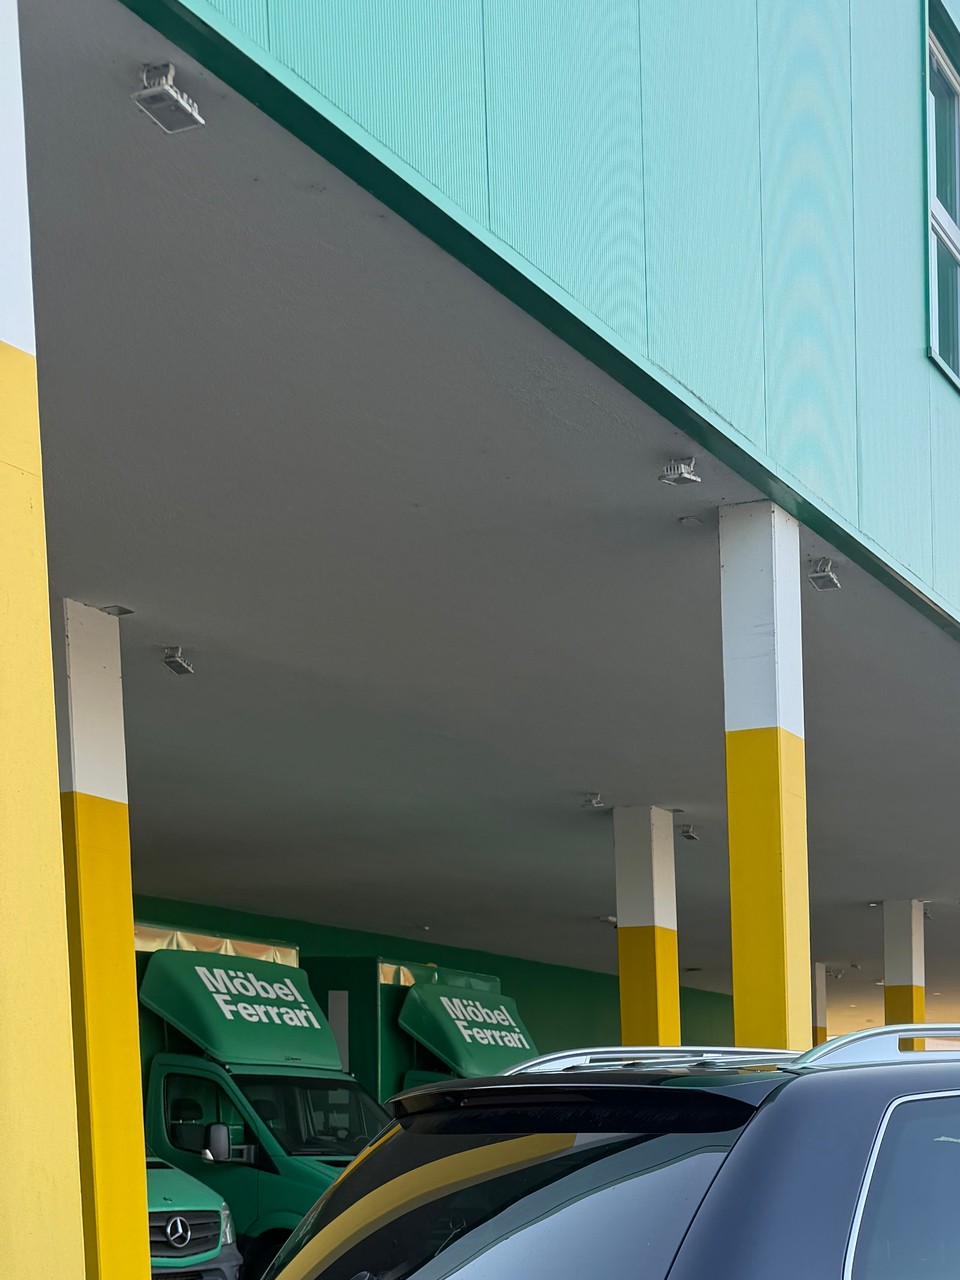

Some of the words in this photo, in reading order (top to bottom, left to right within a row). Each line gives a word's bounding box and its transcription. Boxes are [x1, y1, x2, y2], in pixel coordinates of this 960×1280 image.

[194, 966, 305, 1003] Möbel
[212, 993, 321, 1029] Ferrari
[440, 996, 517, 1027] Möbel
[455, 1020, 530, 1050] Ferrari
